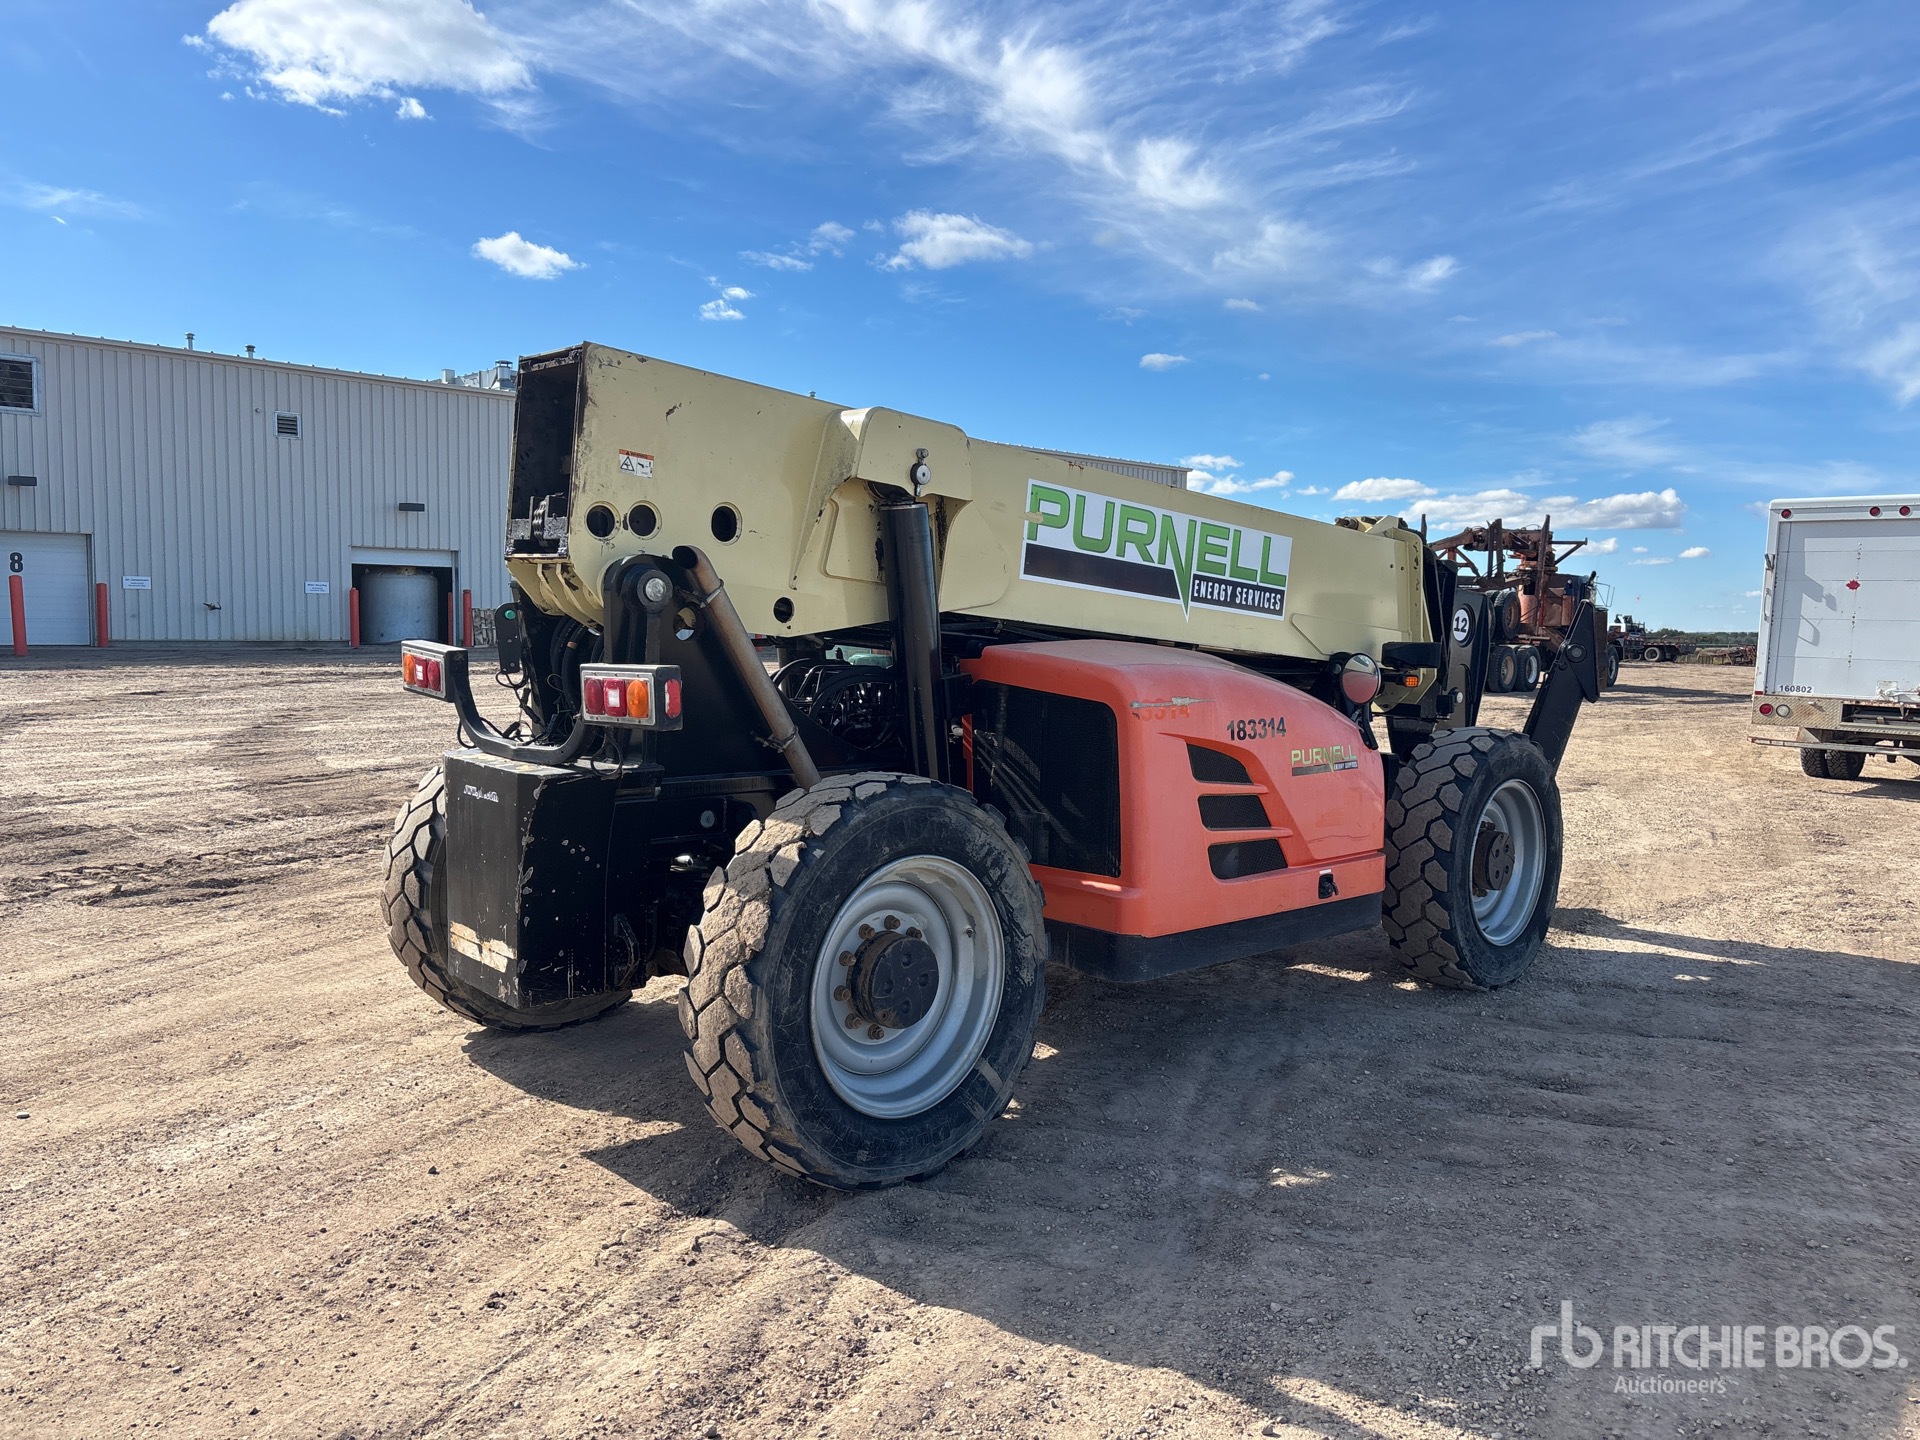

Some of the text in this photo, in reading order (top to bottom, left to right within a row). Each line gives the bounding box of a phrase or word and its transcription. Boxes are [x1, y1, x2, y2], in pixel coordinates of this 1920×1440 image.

[9, 551, 24, 573] 8
[1026, 483, 1287, 617] PURNELL
[1193, 579, 1282, 612] ENERGY SERVICES
[1453, 616, 1468, 634] 12
[1780, 684, 1813, 694] 160802
[1226, 716, 1287, 742] 183314
[1291, 744, 1358, 773] PURNELL
